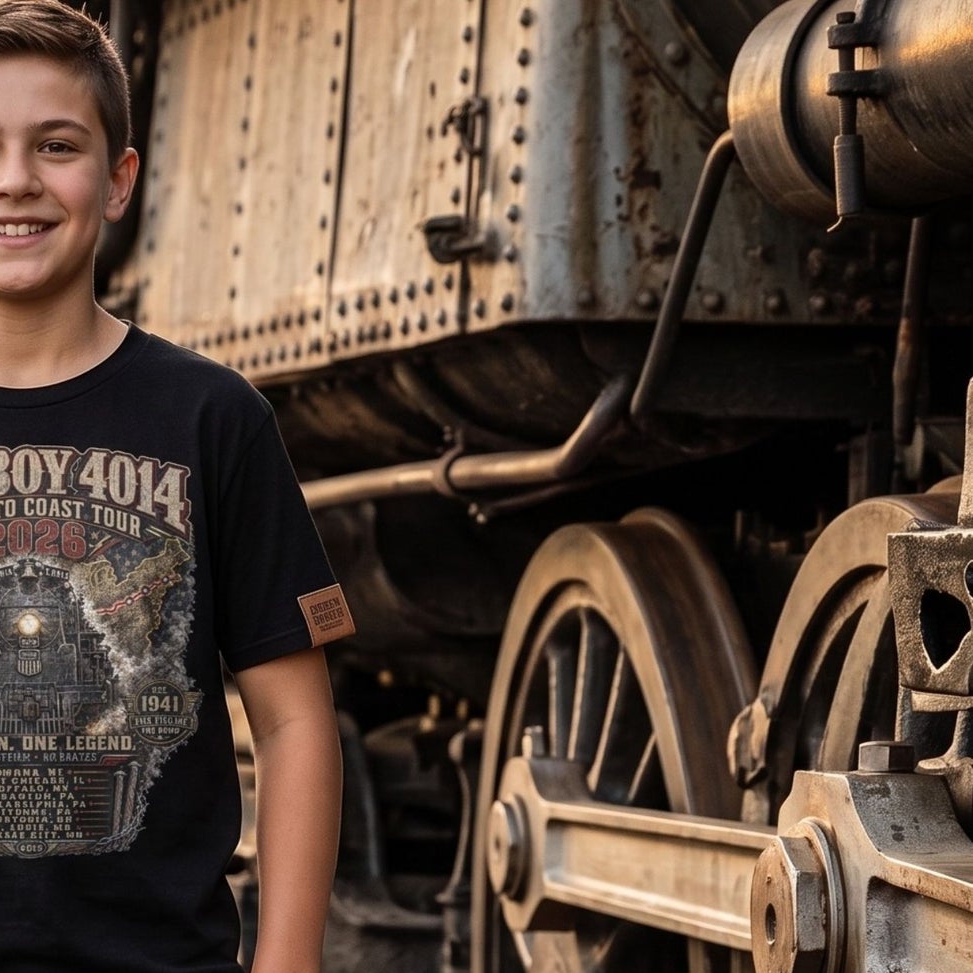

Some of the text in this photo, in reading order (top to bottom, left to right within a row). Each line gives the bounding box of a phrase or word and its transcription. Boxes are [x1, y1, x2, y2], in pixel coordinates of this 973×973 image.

[79, 450, 187, 535] 4014
[23, 497, 85, 520] COAST
[91, 503, 141, 538] TOUR
[141, 695, 179, 712] 1941
[22, 735, 63, 751] ONE
